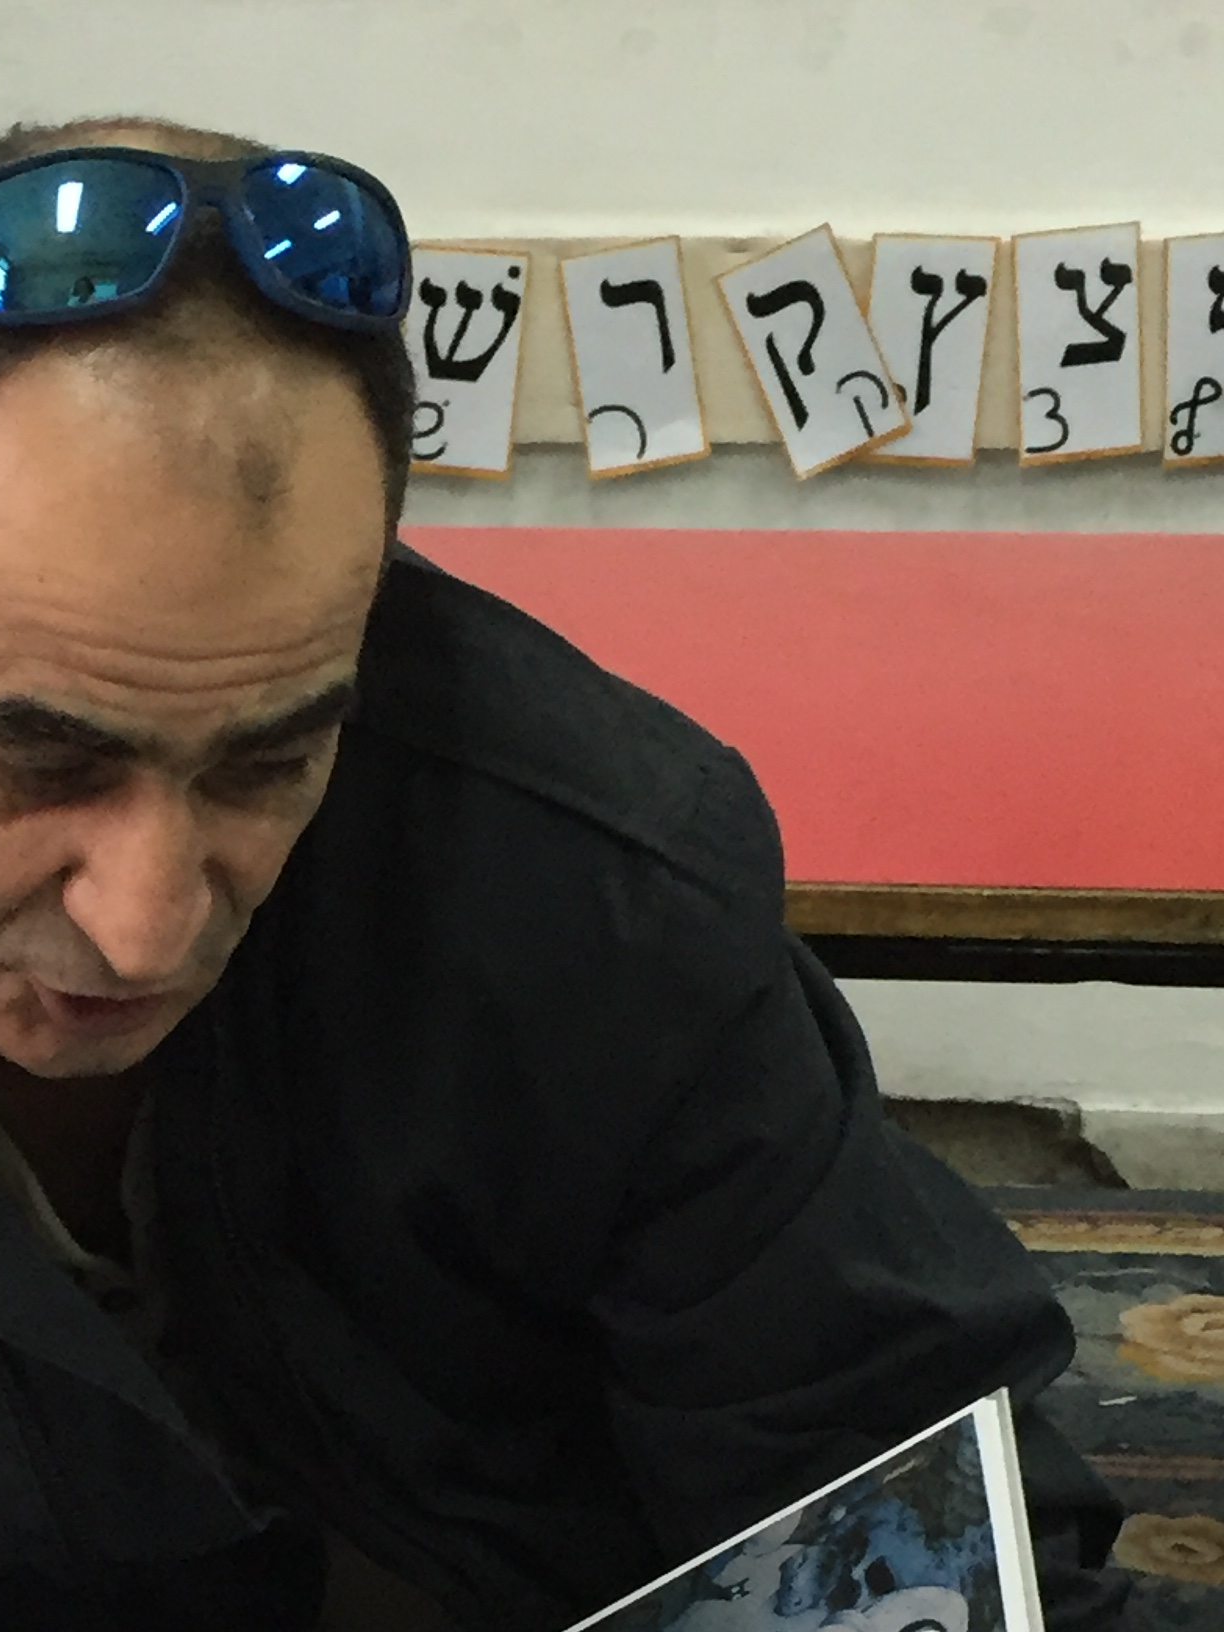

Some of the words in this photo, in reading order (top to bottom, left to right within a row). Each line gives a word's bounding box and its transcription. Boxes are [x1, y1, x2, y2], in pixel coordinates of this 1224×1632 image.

[600, 279, 675, 374] ר
[746, 280, 825, 432] ק
[910, 265, 987, 416] ץ
[1054, 257, 1133, 367] צ
